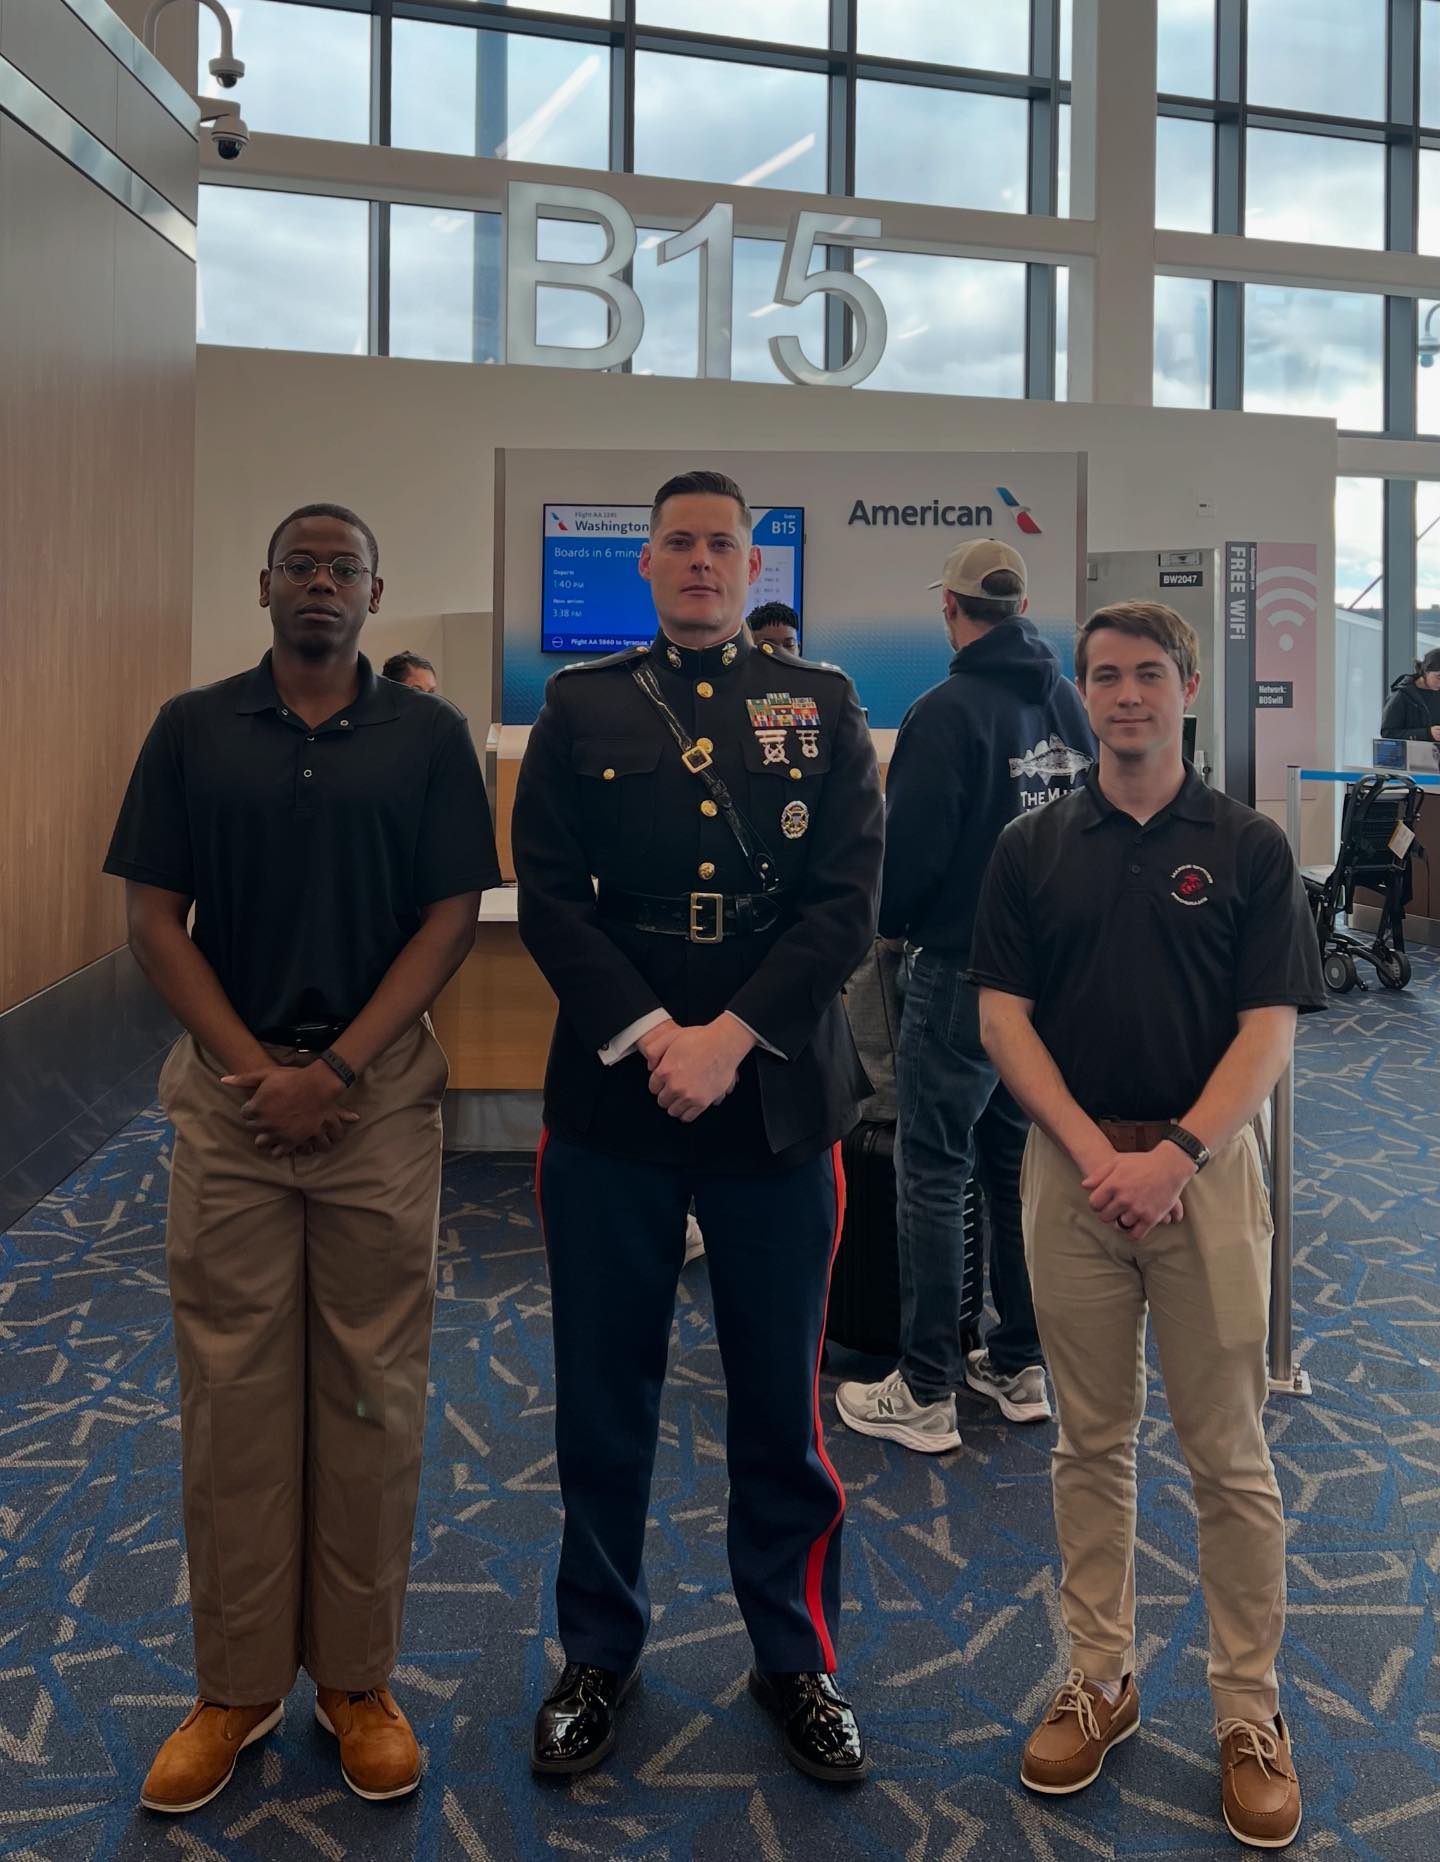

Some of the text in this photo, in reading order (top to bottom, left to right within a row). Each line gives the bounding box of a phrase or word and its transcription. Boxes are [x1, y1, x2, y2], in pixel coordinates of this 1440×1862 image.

[505, 180, 888, 387] B15
[848, 500, 993, 526] American
[575, 520, 650, 535] Washington
[771, 521, 796, 535] B15
[554, 547, 642, 559] Boards in 6 minu
[1230, 546, 1247, 593] FREE
[1163, 575, 1198, 584] BW2047
[1020, 790, 1046, 808] THE
[877, 1397, 895, 1416] N
